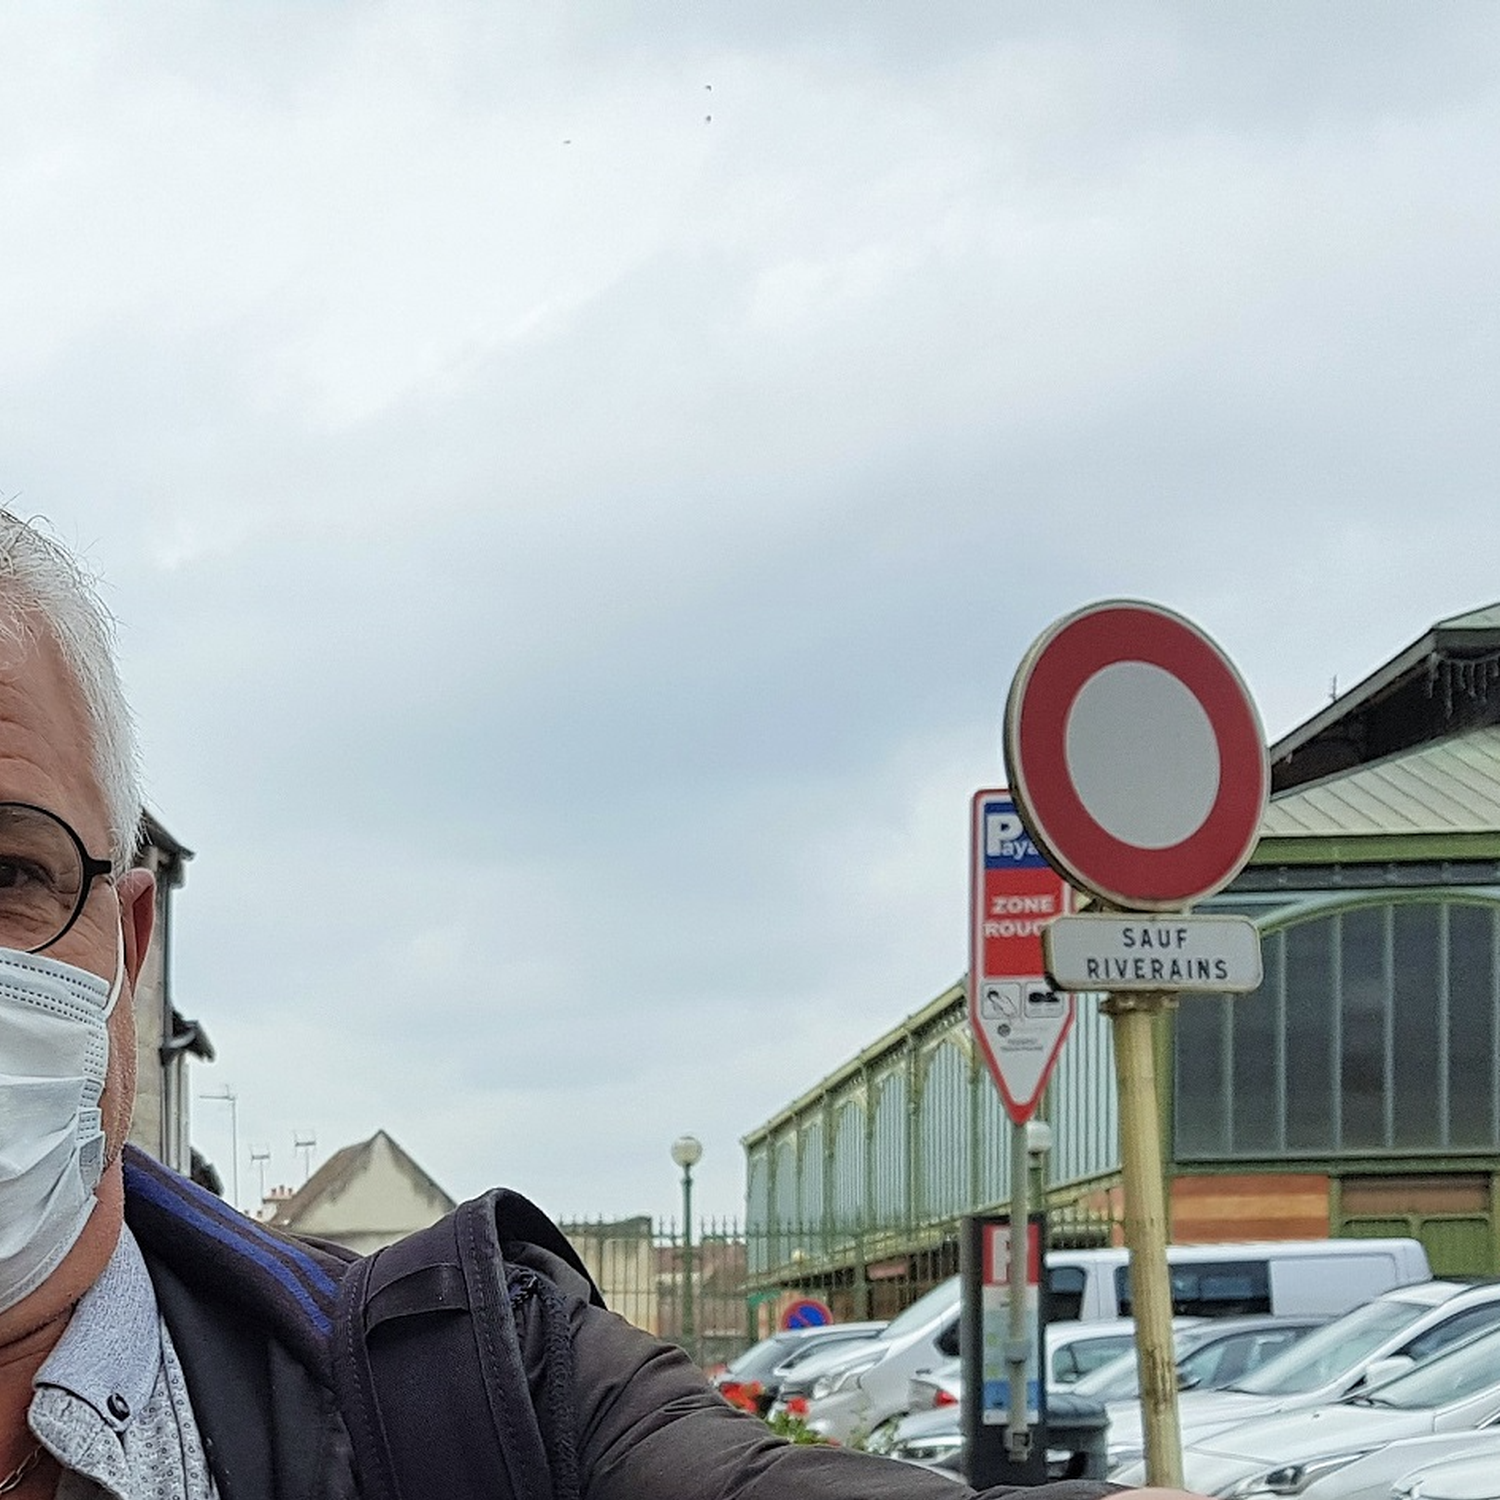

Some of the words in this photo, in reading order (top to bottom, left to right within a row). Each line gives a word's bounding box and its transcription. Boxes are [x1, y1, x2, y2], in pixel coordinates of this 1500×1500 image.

[992, 896, 1055, 914] ZONE
[1122, 928, 1188, 949] SAUF
[1086, 958, 1229, 980] RIVERAINS
